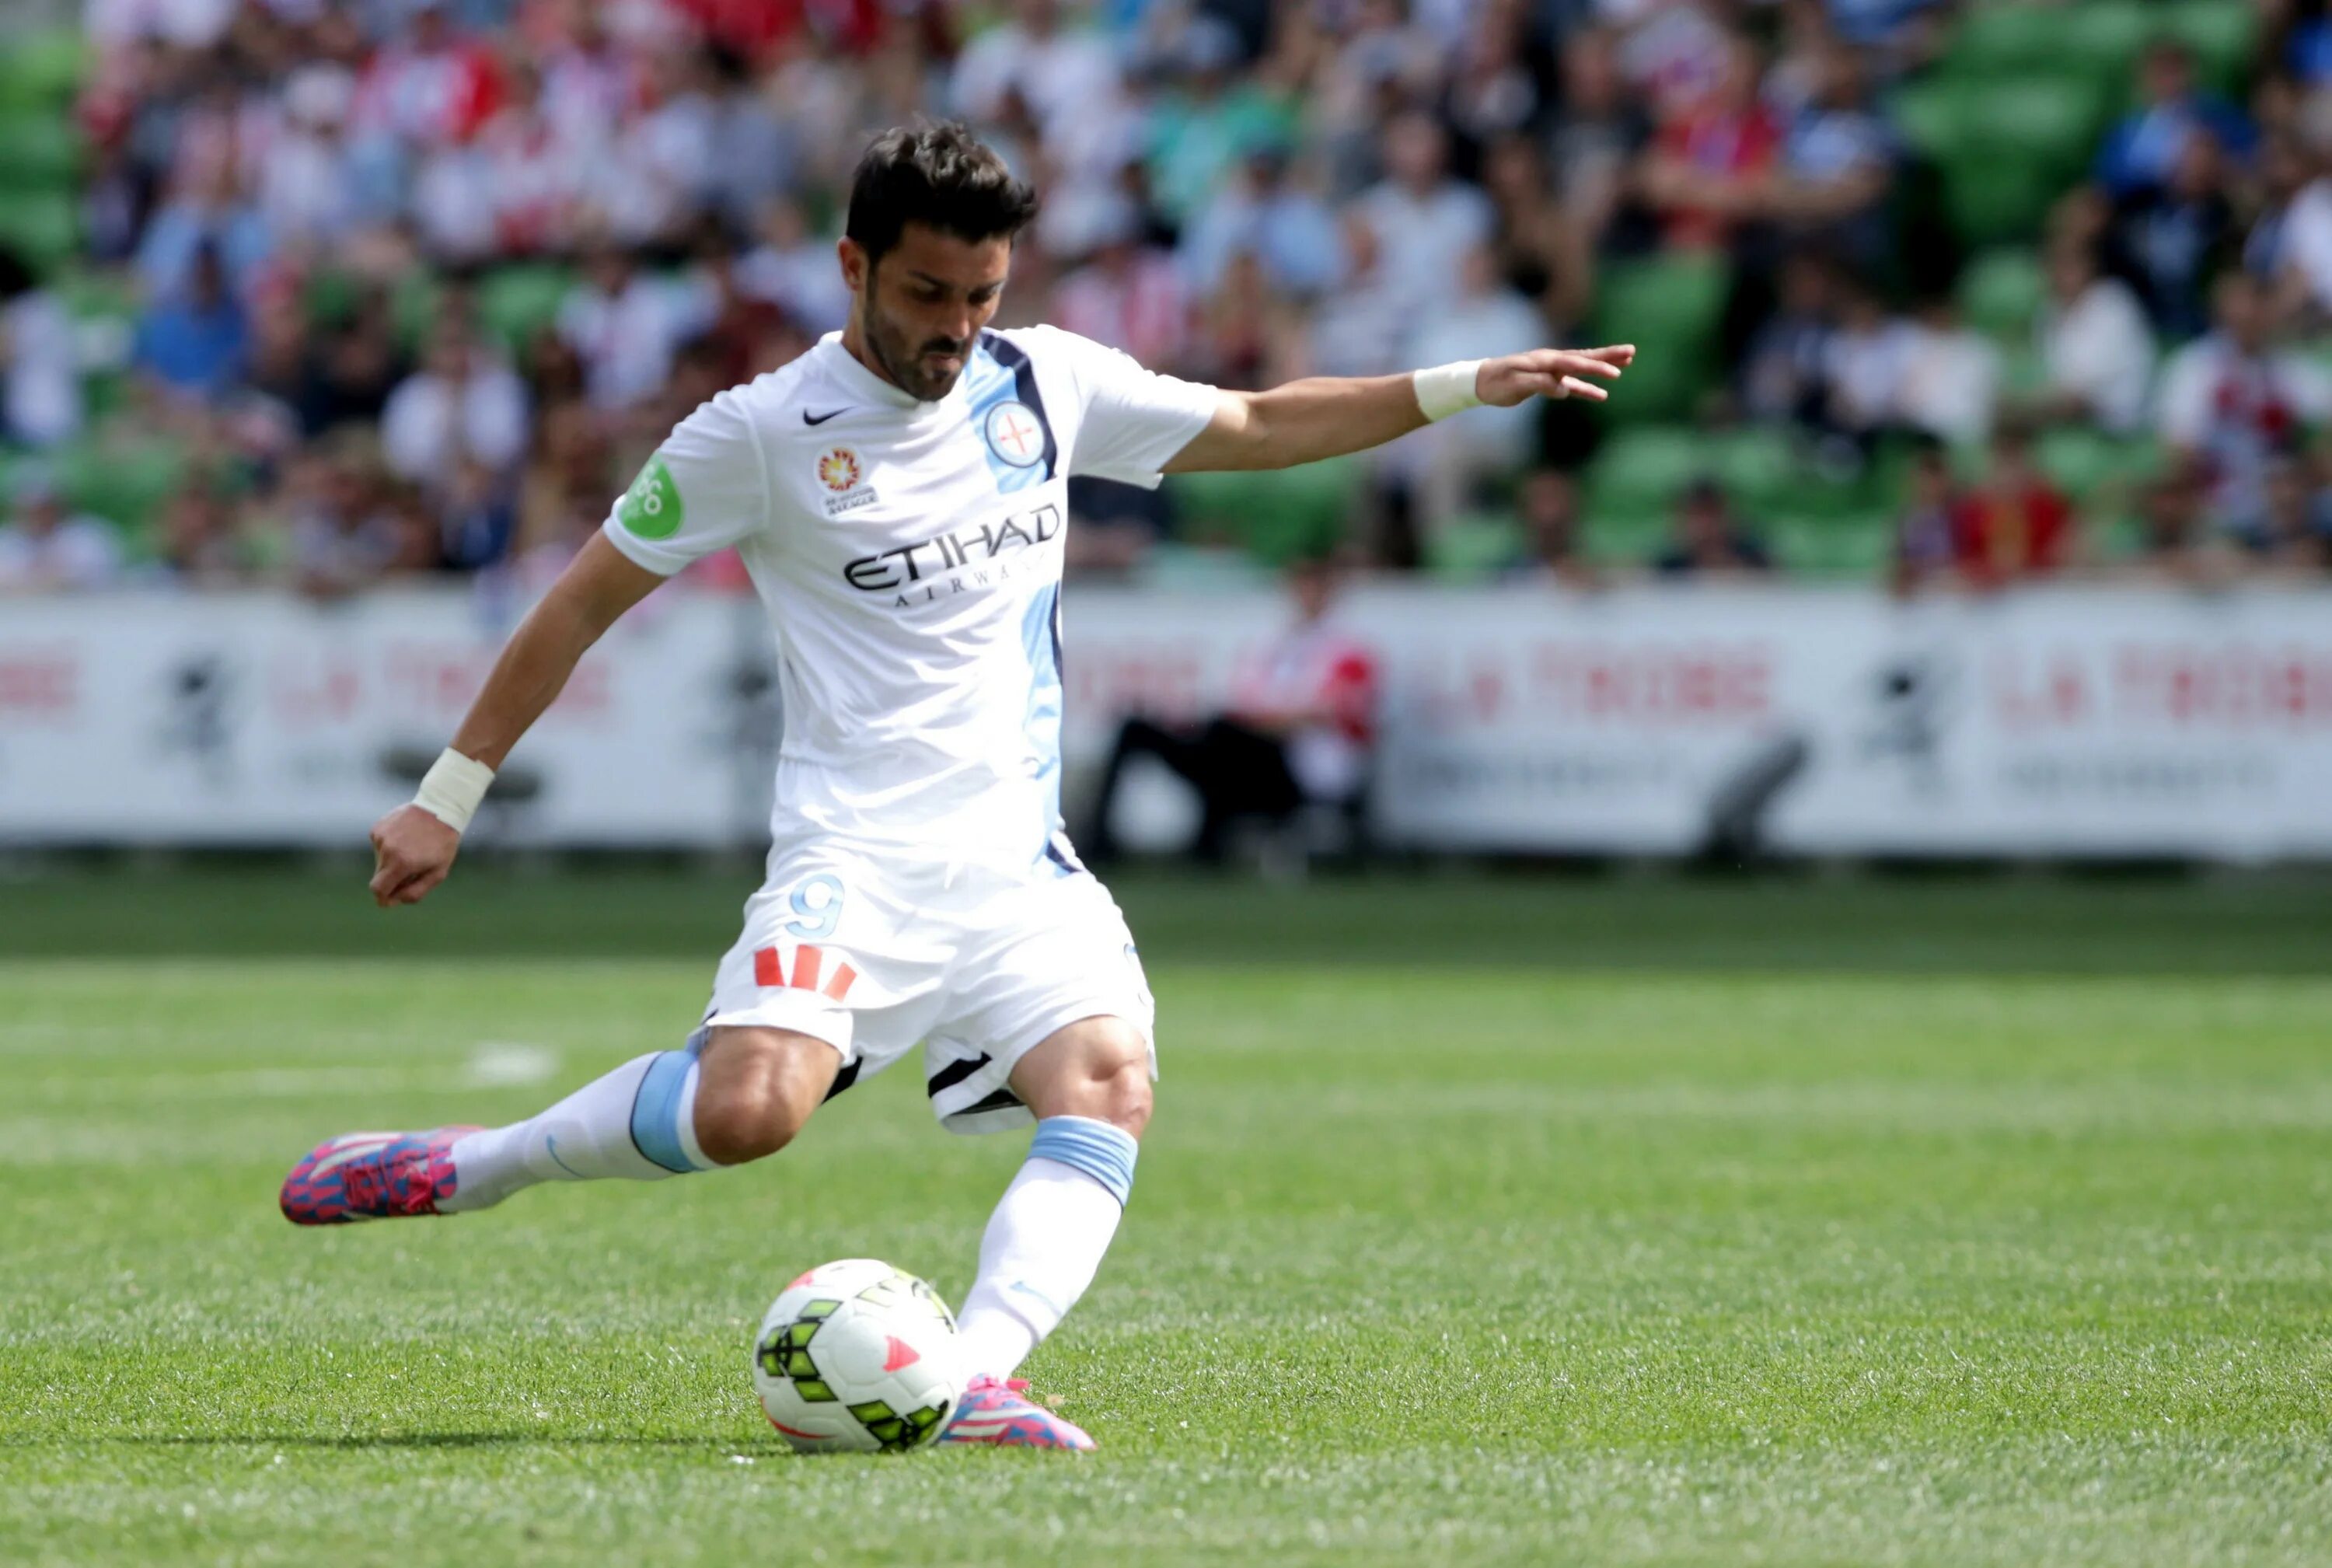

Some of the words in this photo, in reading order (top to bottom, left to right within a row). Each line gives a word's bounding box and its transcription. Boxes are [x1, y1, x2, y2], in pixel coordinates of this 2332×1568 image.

[843, 502, 1060, 591] ETIHAD
[895, 548, 1046, 607] AIRWA
[784, 873, 845, 939] 9
